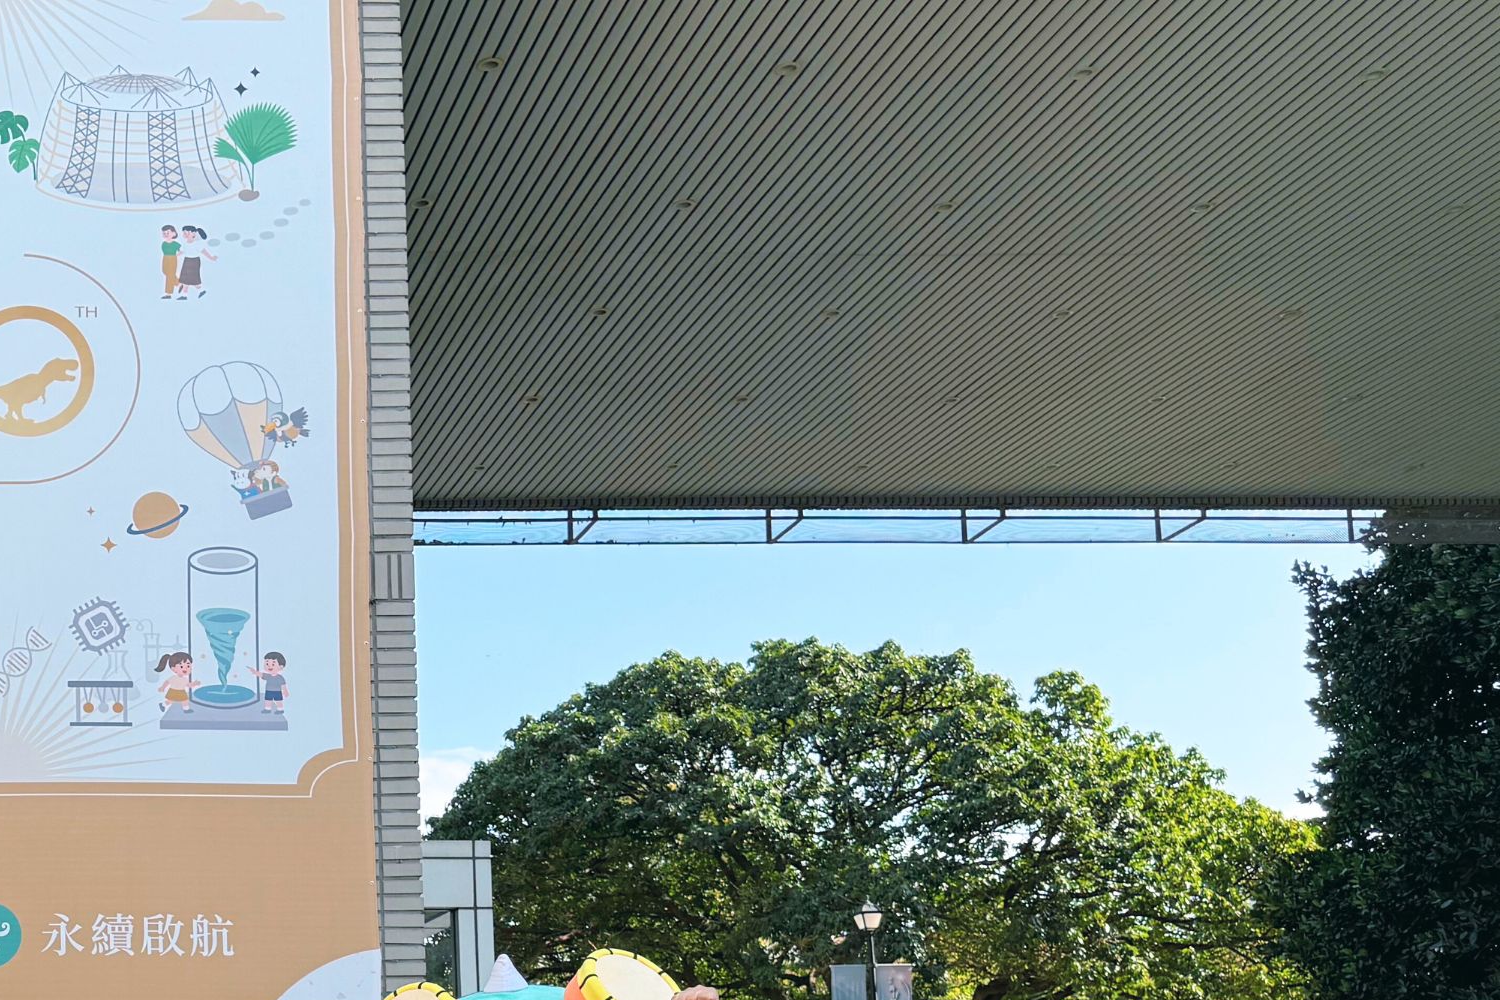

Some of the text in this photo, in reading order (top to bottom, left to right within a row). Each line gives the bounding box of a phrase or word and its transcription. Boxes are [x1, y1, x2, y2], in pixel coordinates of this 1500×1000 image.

[74, 306, 98, 318] TH
[40, 912, 235, 958] 永續啟航
